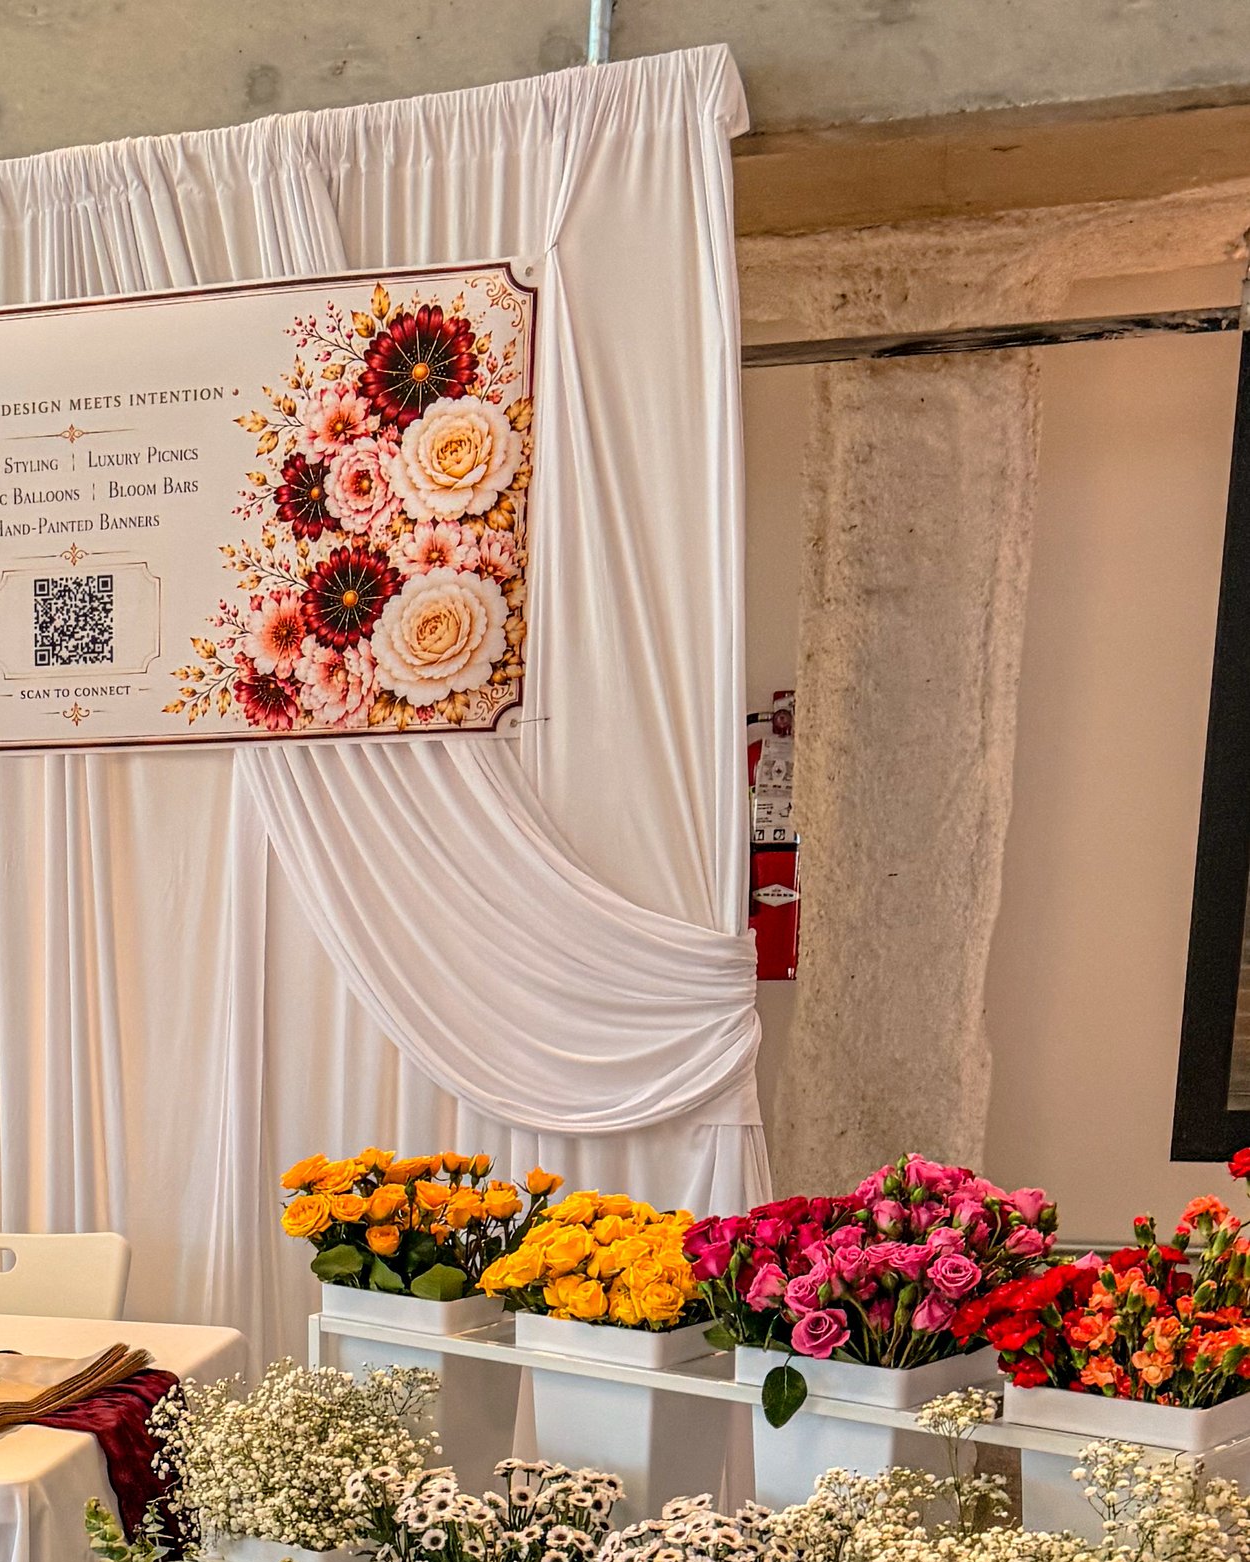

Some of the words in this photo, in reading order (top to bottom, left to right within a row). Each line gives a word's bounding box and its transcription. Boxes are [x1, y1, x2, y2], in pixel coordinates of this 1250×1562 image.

[1, 399, 62, 417] DESIGN
[69, 394, 122, 412] MEETS
[129, 386, 226, 407] INTENTION
[4, 456, 59, 475] STYLING
[88, 450, 140, 468] LUXURY
[147, 446, 199, 464] PICNICS
[13, 488, 80, 506] BALLOONS
[109, 481, 157, 499] BLOOM
[163, 477, 199, 495] BARS
[99, 514, 160, 532] BANNERS
[20, 688, 51, 701] SCAN
[53, 688, 71, 699] TO
[74, 685, 131, 698] CONNECT
